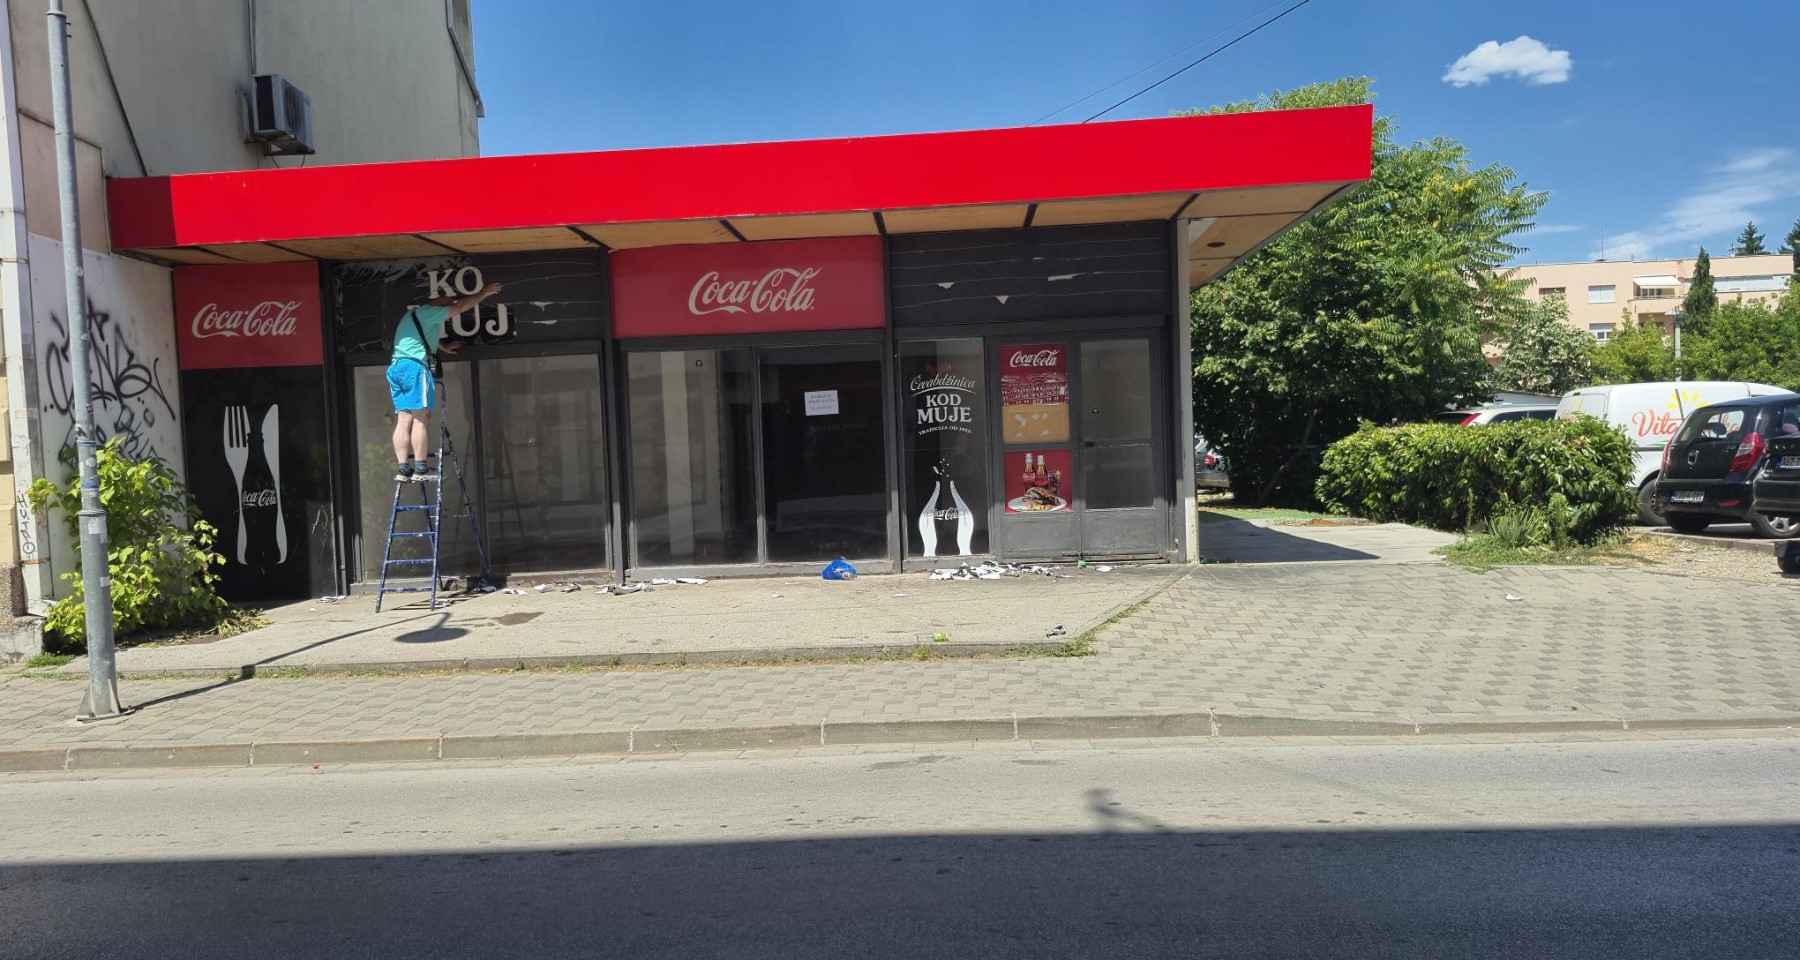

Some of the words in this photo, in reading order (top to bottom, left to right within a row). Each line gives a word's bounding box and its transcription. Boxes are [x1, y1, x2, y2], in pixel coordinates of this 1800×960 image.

[427, 266, 484, 299] KO
[688, 267, 822, 316] Coca-Cola
[192, 300, 302, 338] Coca-Cola
[1009, 349, 1061, 368] Coca-Cola
[927, 395, 962, 407] KOD
[917, 407, 972, 424] MUJE
